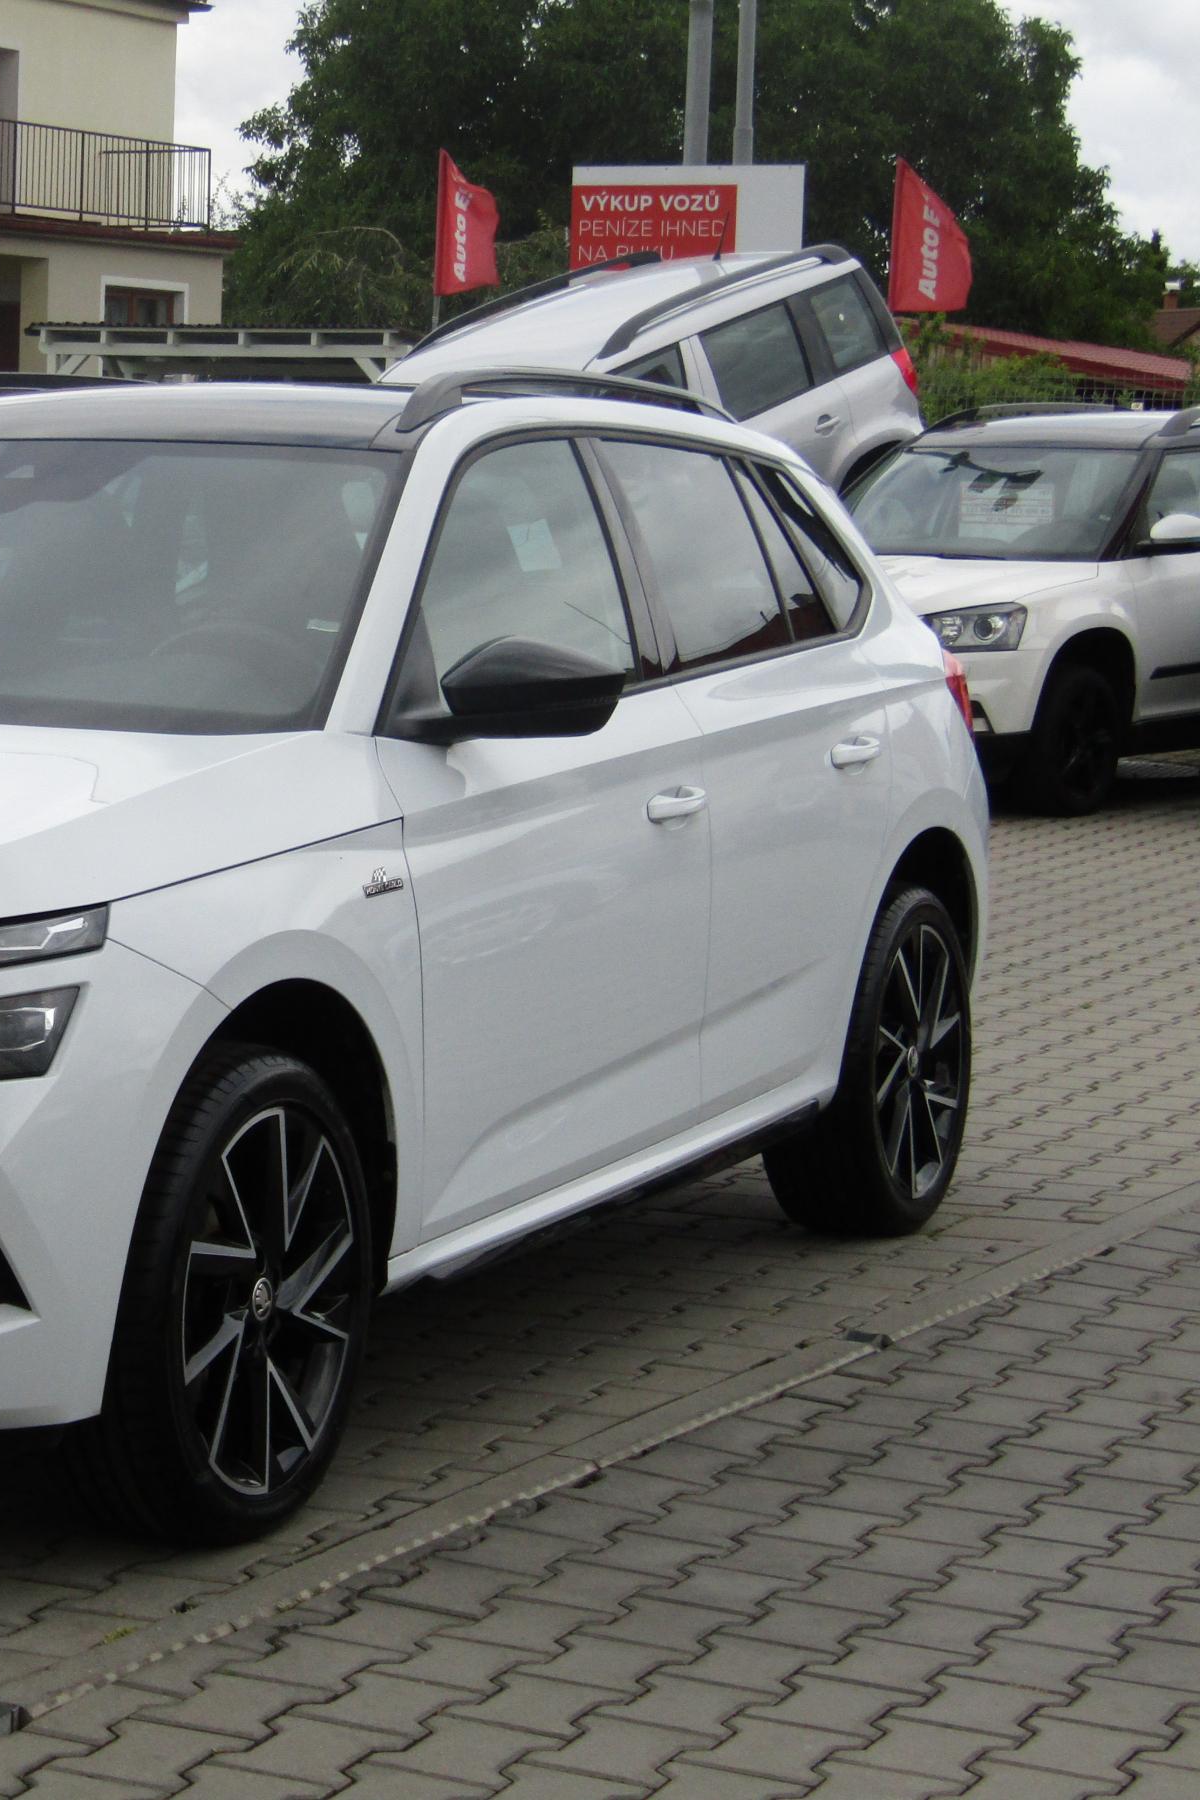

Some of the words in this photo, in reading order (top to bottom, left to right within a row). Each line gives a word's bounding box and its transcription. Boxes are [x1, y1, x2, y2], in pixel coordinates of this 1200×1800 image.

[581, 191, 653, 212] VÝKUP
[659, 190, 719, 212] VOZŮ
[579, 217, 652, 237] PENÍZE
[661, 220, 725, 237] IHNED
[453, 212, 467, 283] Auto
[578, 245, 608, 261] NA
[918, 227, 939, 301] Auto
